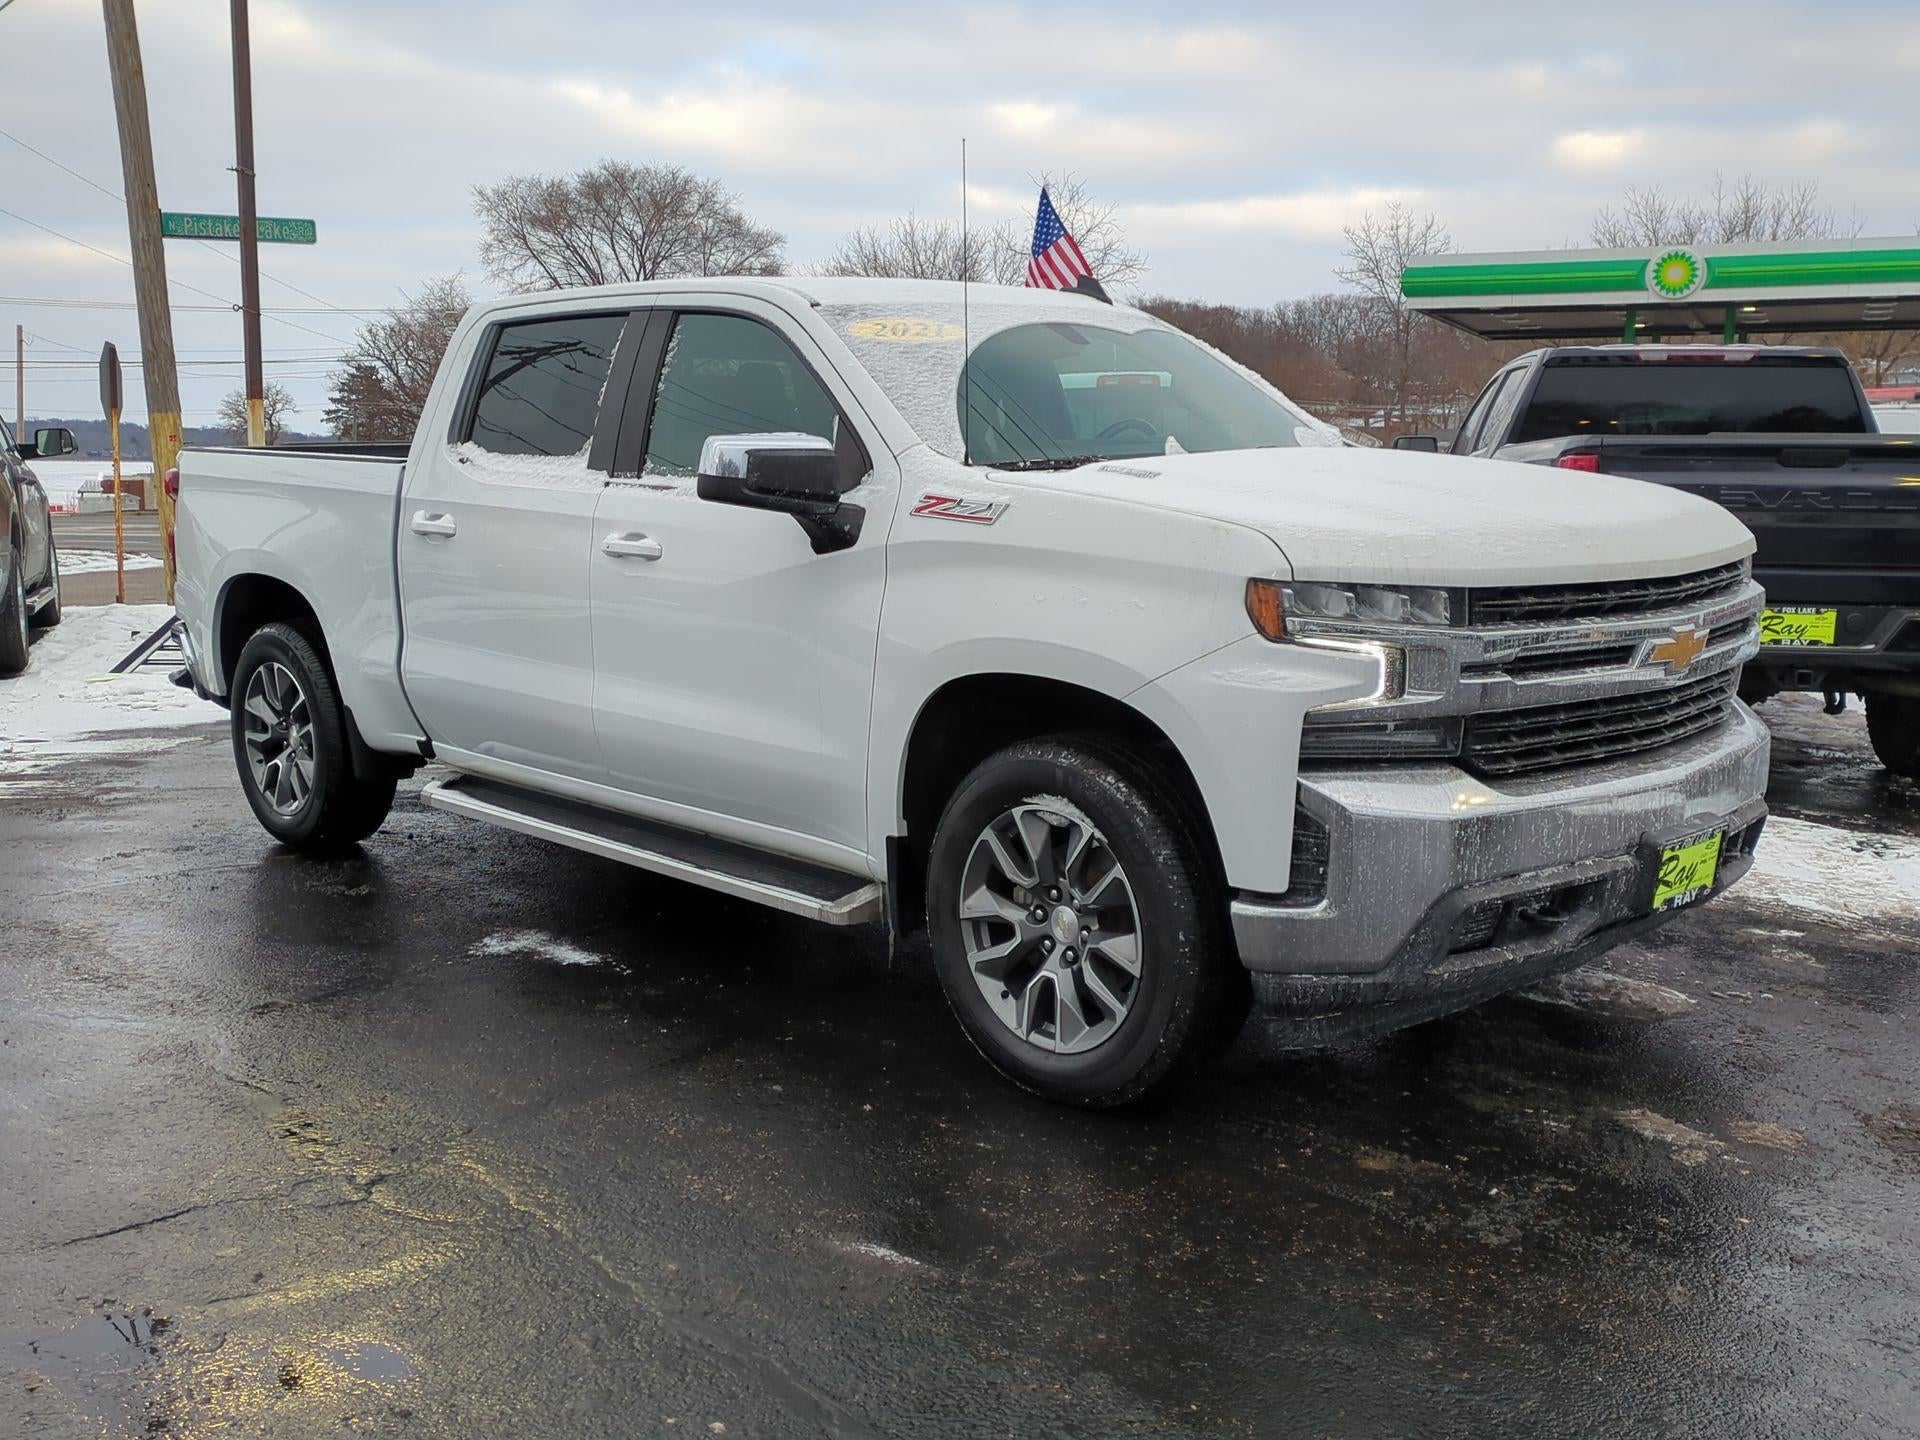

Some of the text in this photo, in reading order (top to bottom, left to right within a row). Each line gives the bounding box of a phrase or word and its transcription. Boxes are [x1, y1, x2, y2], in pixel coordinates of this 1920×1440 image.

[910, 493, 1010, 525] Z71
[1761, 615, 1809, 640] Ray
[1657, 854, 1699, 891] Ray
[1673, 887, 1699, 908] RAY
